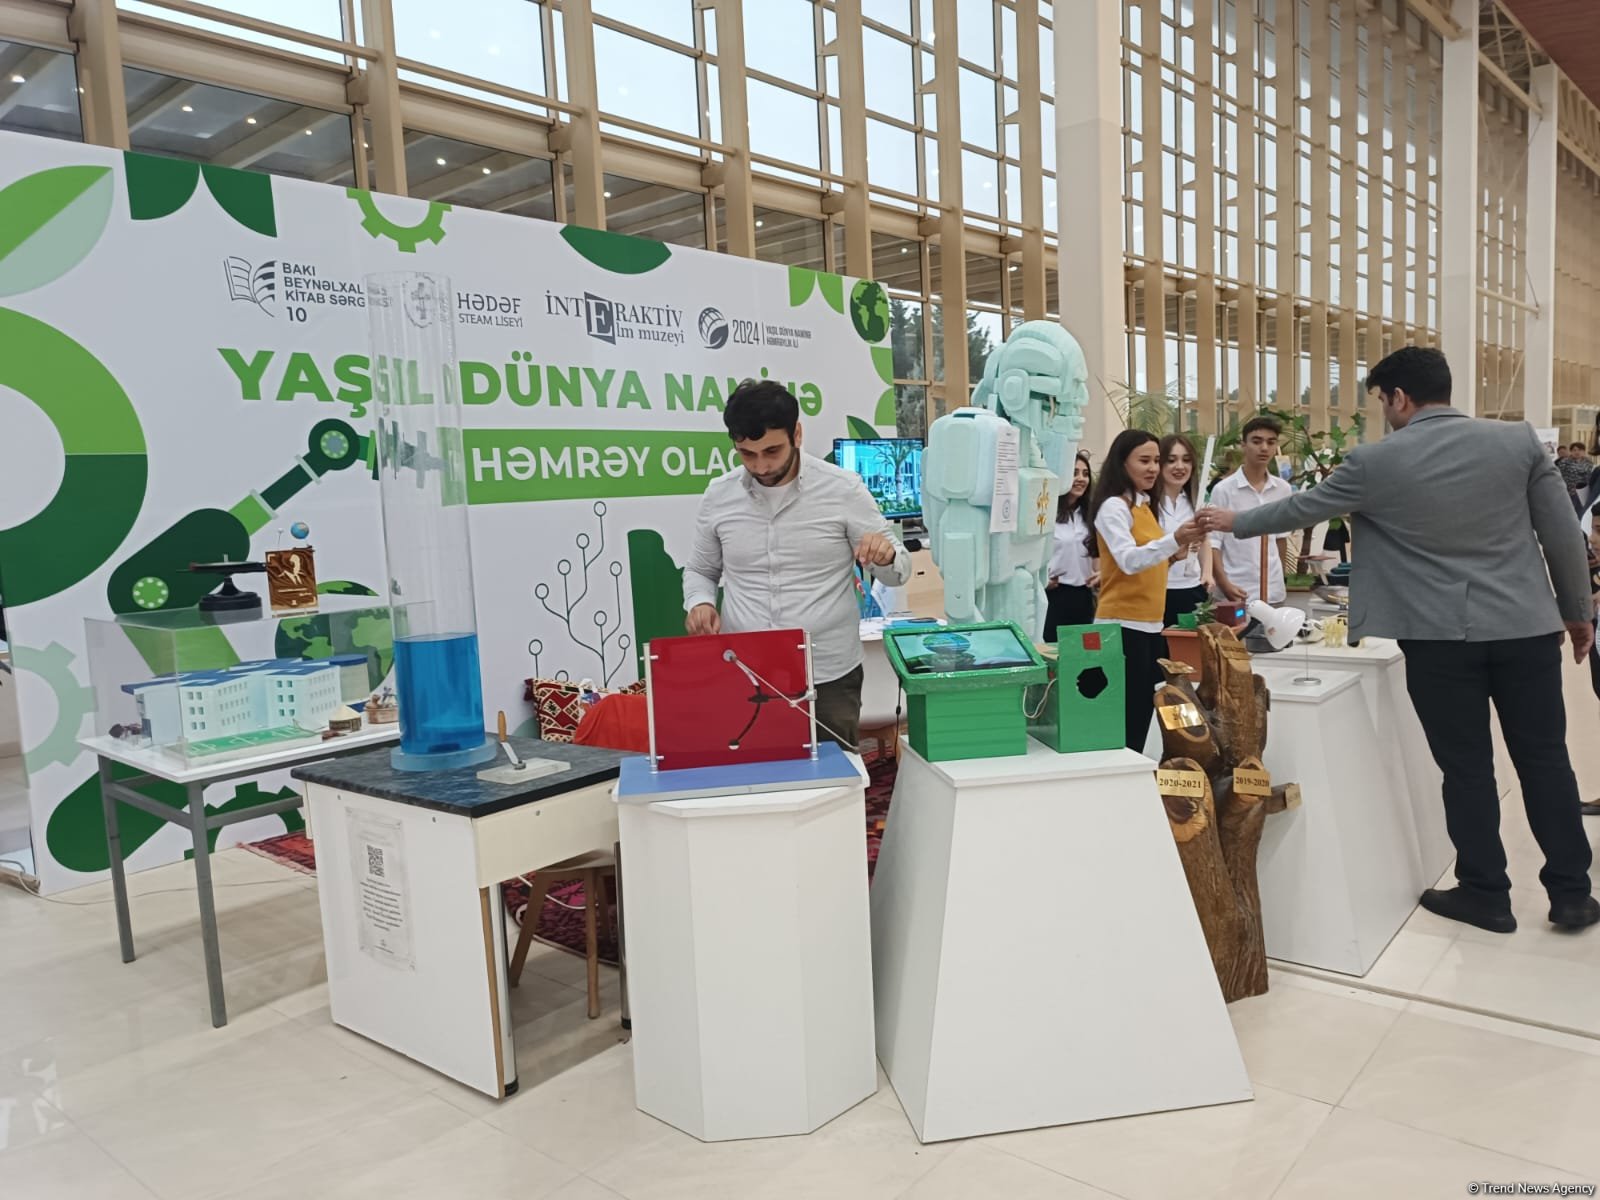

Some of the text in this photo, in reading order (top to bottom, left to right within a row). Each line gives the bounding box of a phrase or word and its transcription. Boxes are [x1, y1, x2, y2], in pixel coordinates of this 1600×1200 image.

[282, 262, 316, 276] BAKI
[283, 276, 366, 295] BEYNƏLXAL
[285, 289, 326, 304] KİTAB
[457, 292, 521, 314] HƏDƏF
[286, 306, 308, 323] 10
[459, 312, 493, 326] STEAM
[638, 328, 685, 347] muzeyi
[732, 319, 760, 345] 2024
[459, 350, 652, 410] DÜNYA
[664, 366, 823, 417] NAƏ
[471, 446, 651, 482] HƏMRƏY
[1158, 777, 1202, 789] 2020-2021
[1235, 775, 1270, 788] 2019-2020
